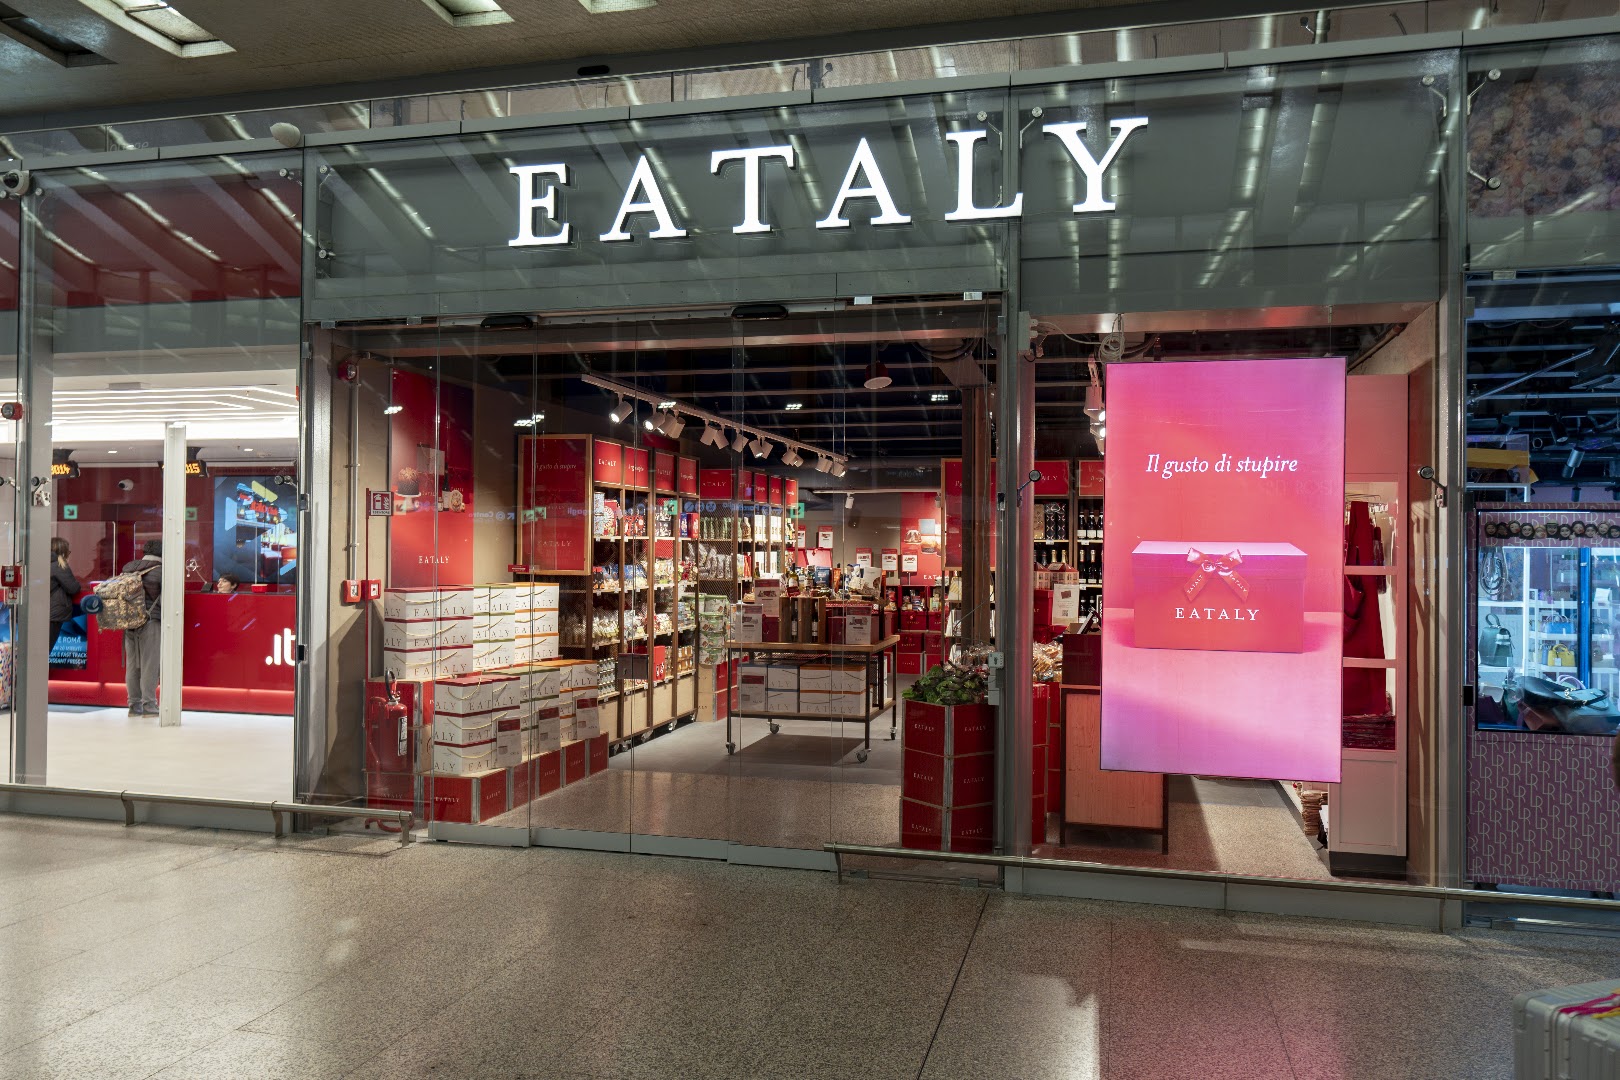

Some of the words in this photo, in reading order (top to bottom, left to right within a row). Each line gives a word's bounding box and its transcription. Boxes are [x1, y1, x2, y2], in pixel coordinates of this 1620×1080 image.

[508, 116, 1149, 247] EATALY
[1145, 453, 1160, 472] Il
[1162, 456, 1209, 479] gusto
[1214, 453, 1232, 472] di
[1236, 455, 1298, 479] stupire
[1175, 607, 1260, 621] EATALY
